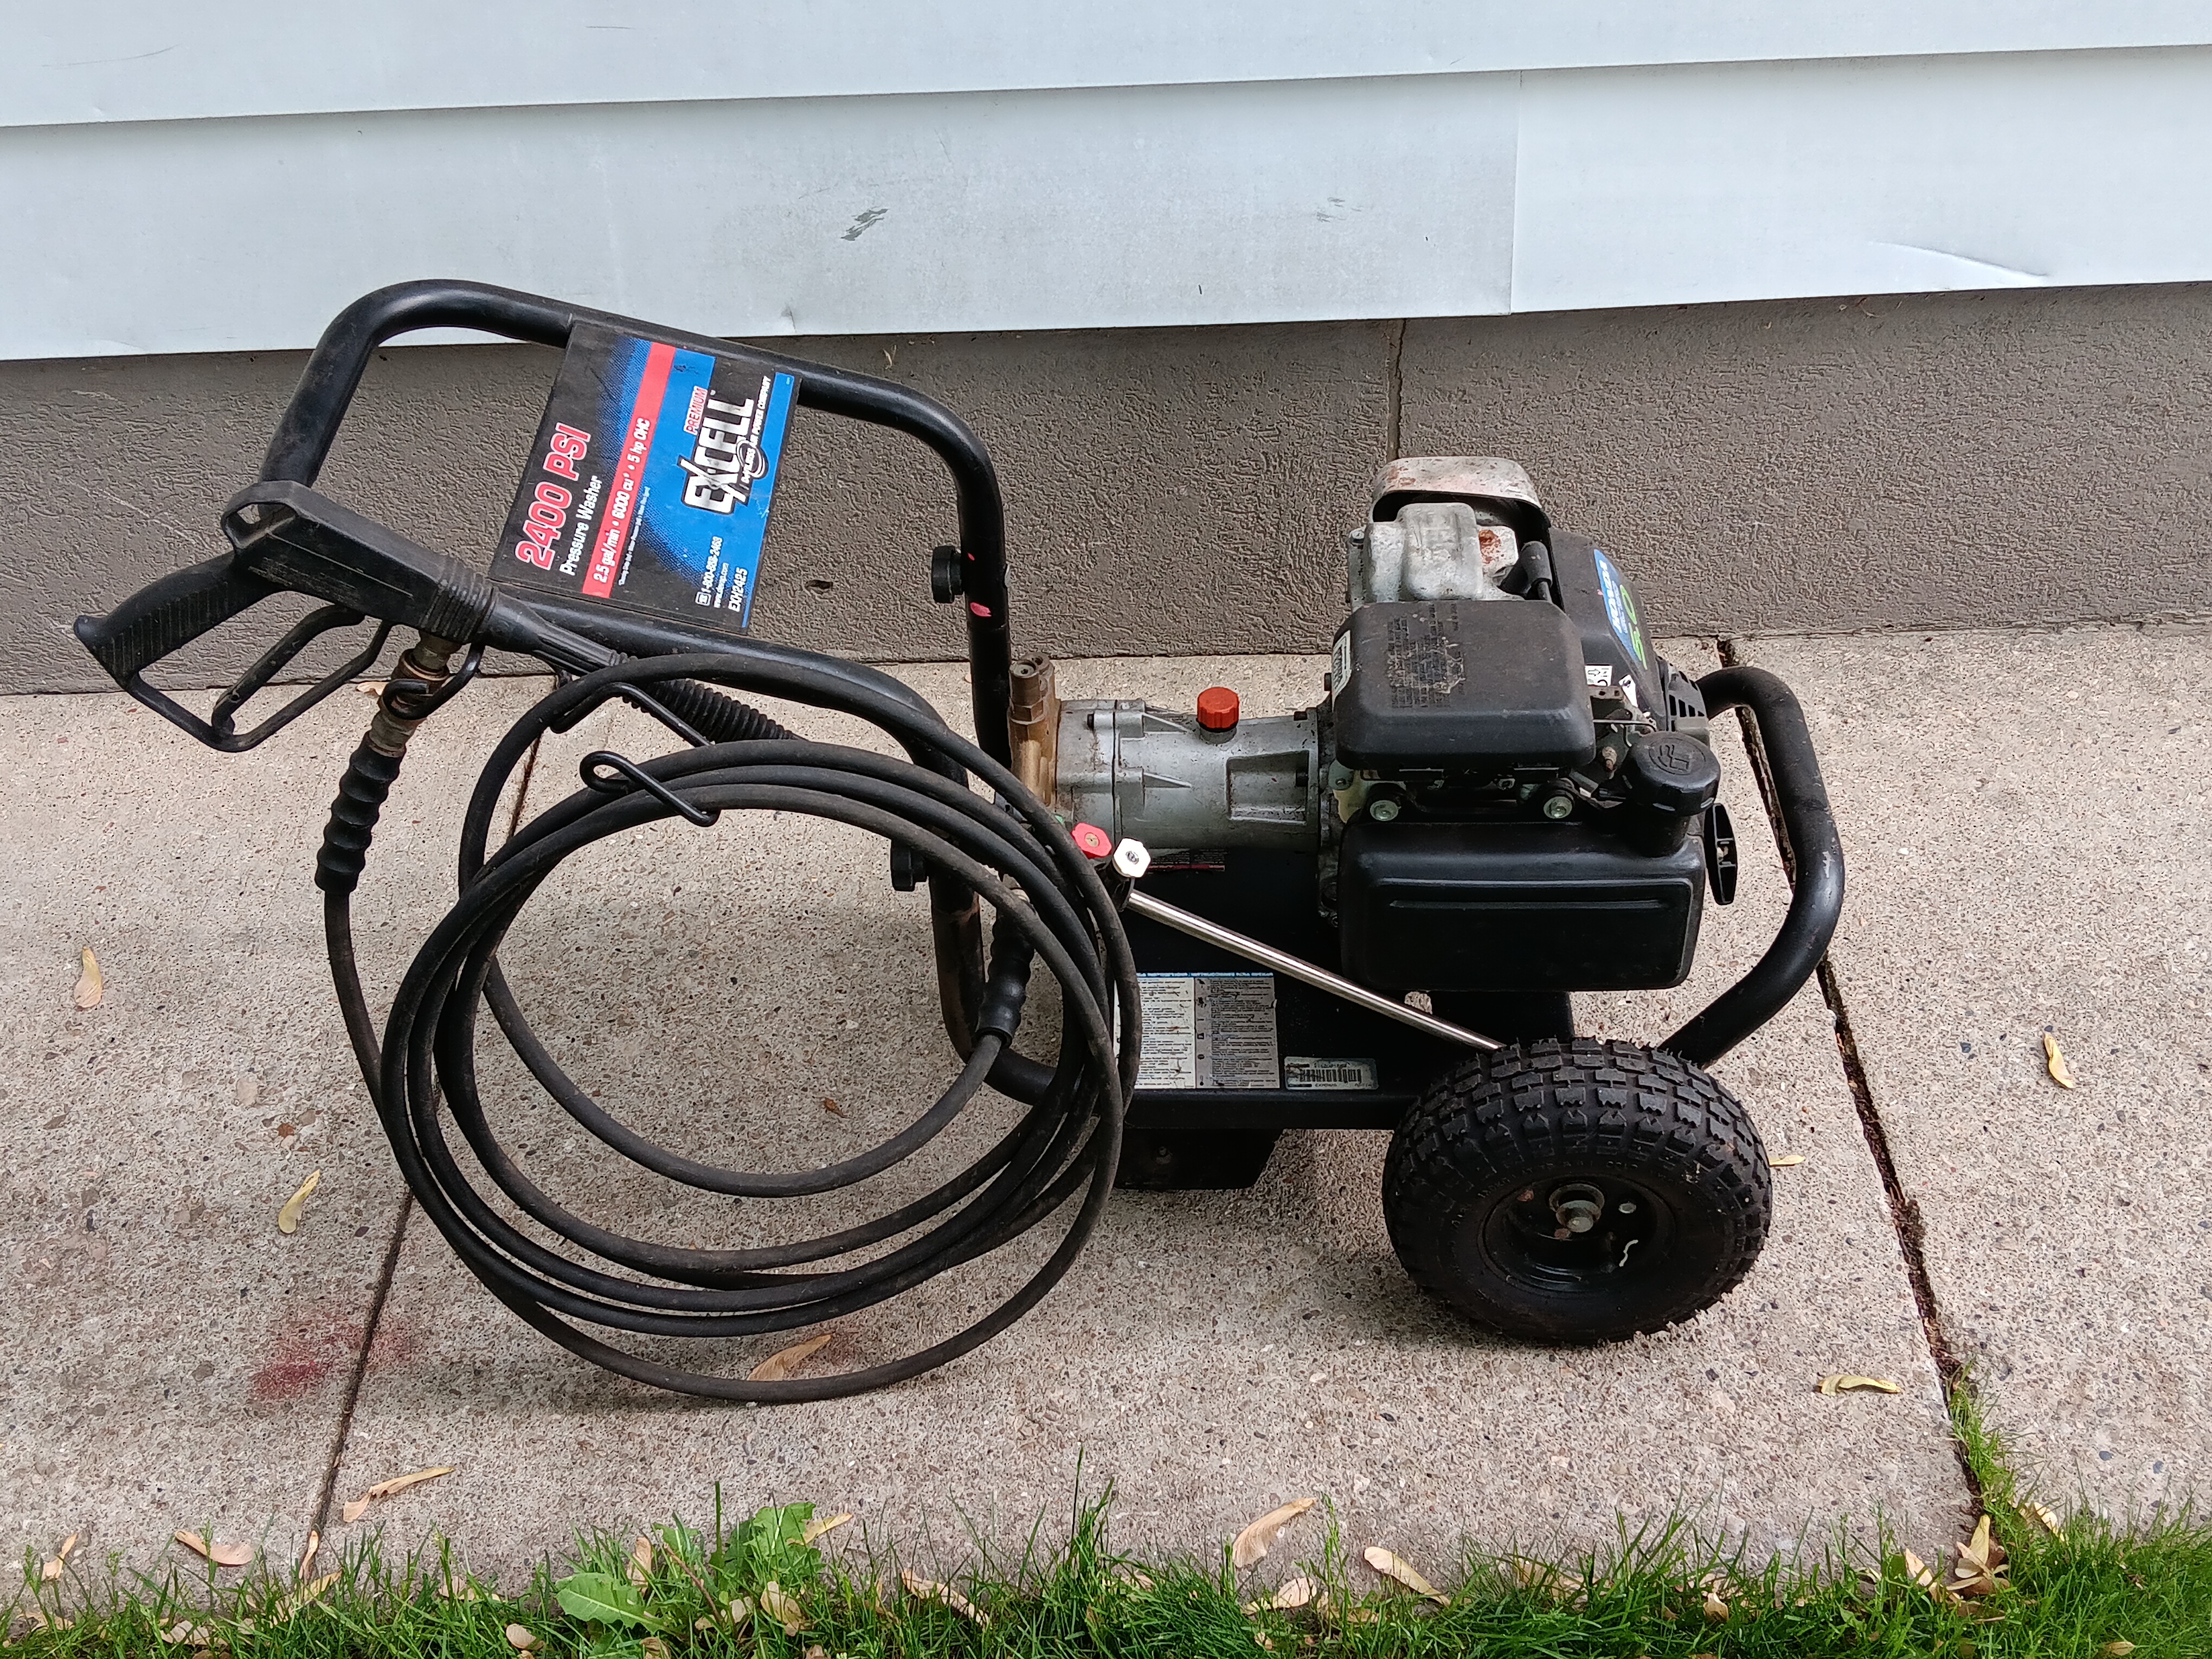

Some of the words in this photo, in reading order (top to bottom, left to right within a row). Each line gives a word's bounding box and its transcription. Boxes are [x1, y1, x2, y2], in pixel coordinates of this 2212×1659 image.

[634, 418, 650, 440] OHC
[684, 385, 708, 435] PREMIUM
[543, 422, 591, 481] PSI
[627, 454, 640, 463] 5
[629, 441, 647, 454] hp
[612, 491, 630, 519] 6000
[515, 481, 572, 570] 2400
[560, 522, 589, 576] Pressure
[576, 475, 602, 520] Washer
[601, 529, 620, 567] gal/min
[594, 564, 609, 583] 2.5
[728, 567, 747, 612] EXH2425
